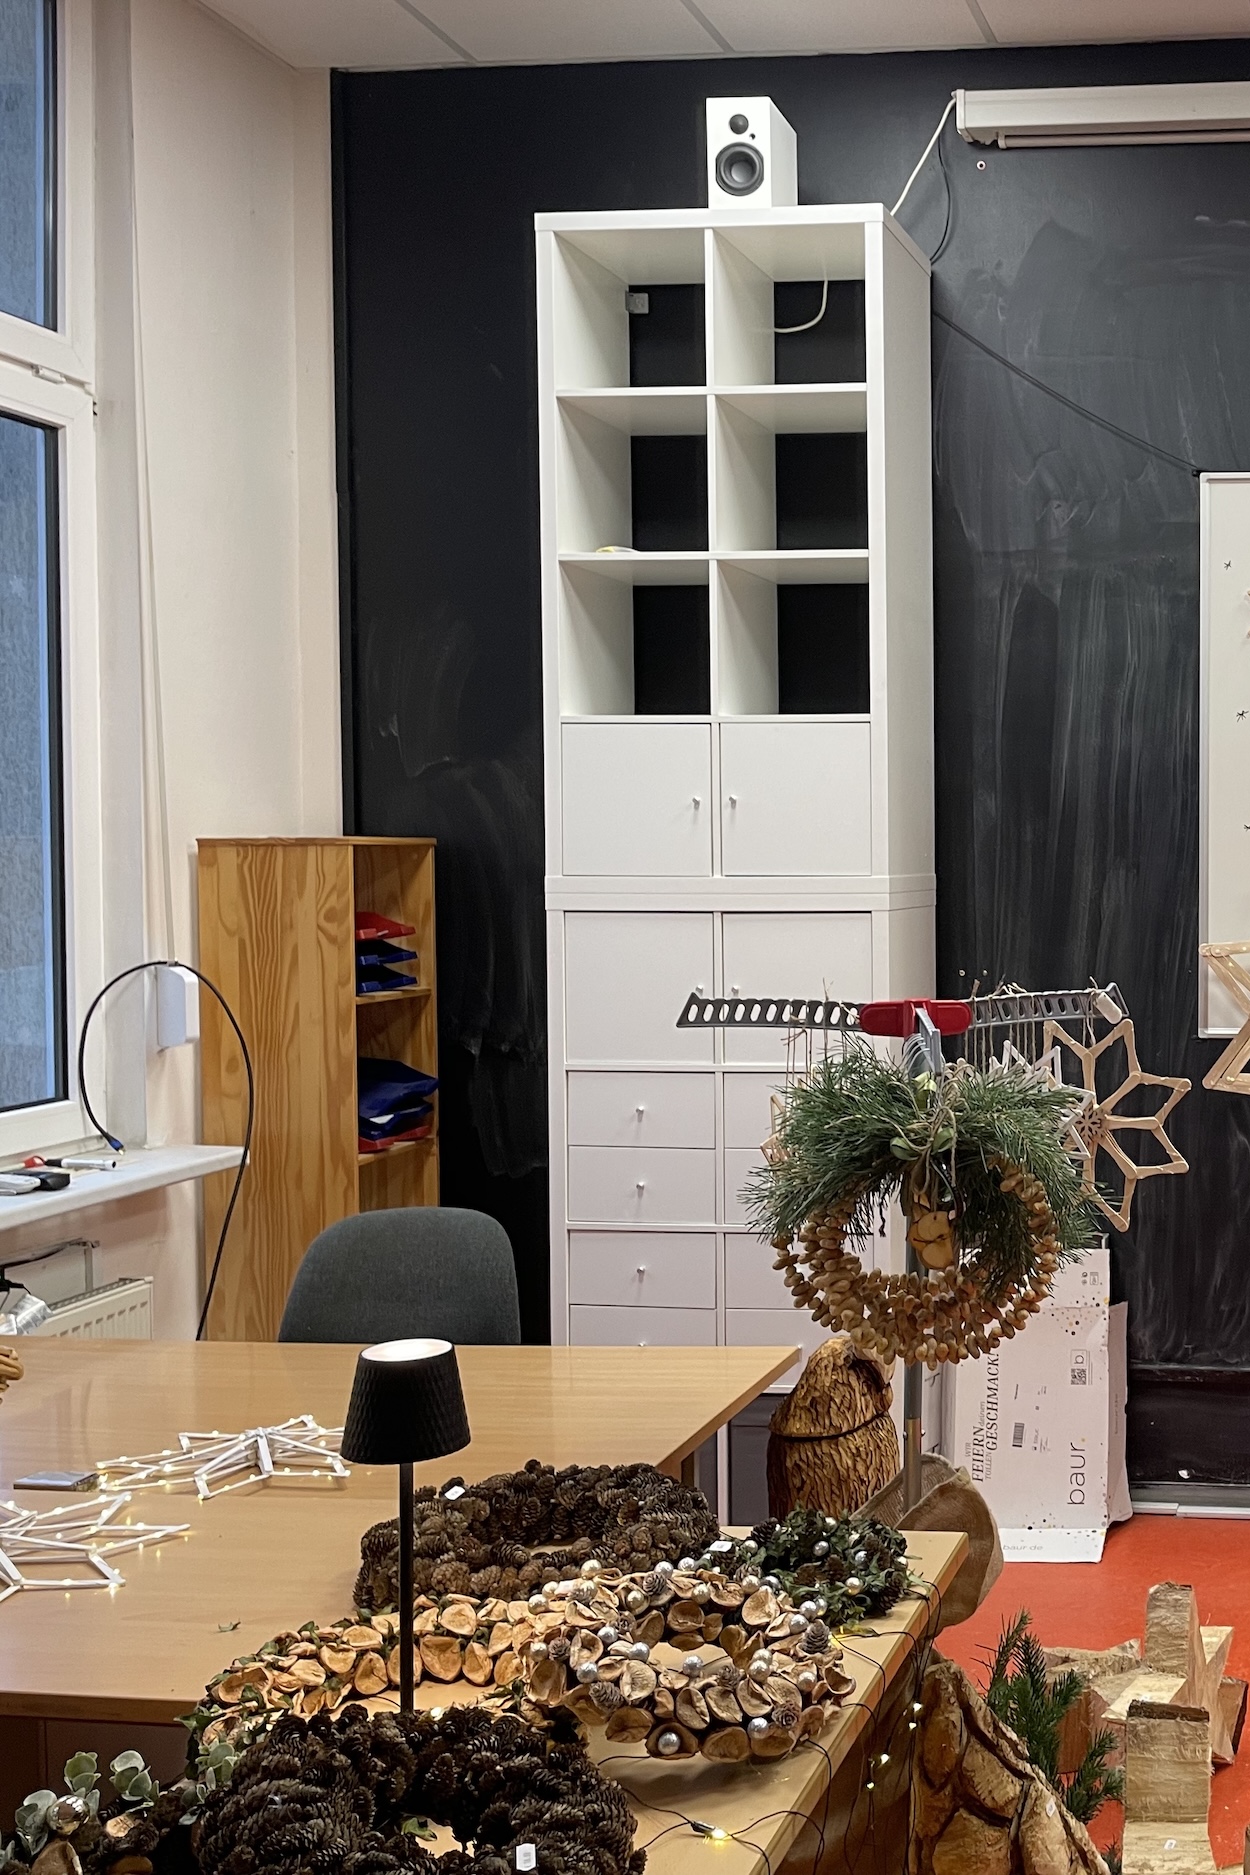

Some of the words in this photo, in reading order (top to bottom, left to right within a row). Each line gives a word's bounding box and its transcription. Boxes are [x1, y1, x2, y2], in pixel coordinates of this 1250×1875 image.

[985, 1352, 1000, 1451] GESCHMACK!
[972, 1426, 985, 1482] FEIERN
[985, 1452, 993, 1480] TOLLEN
